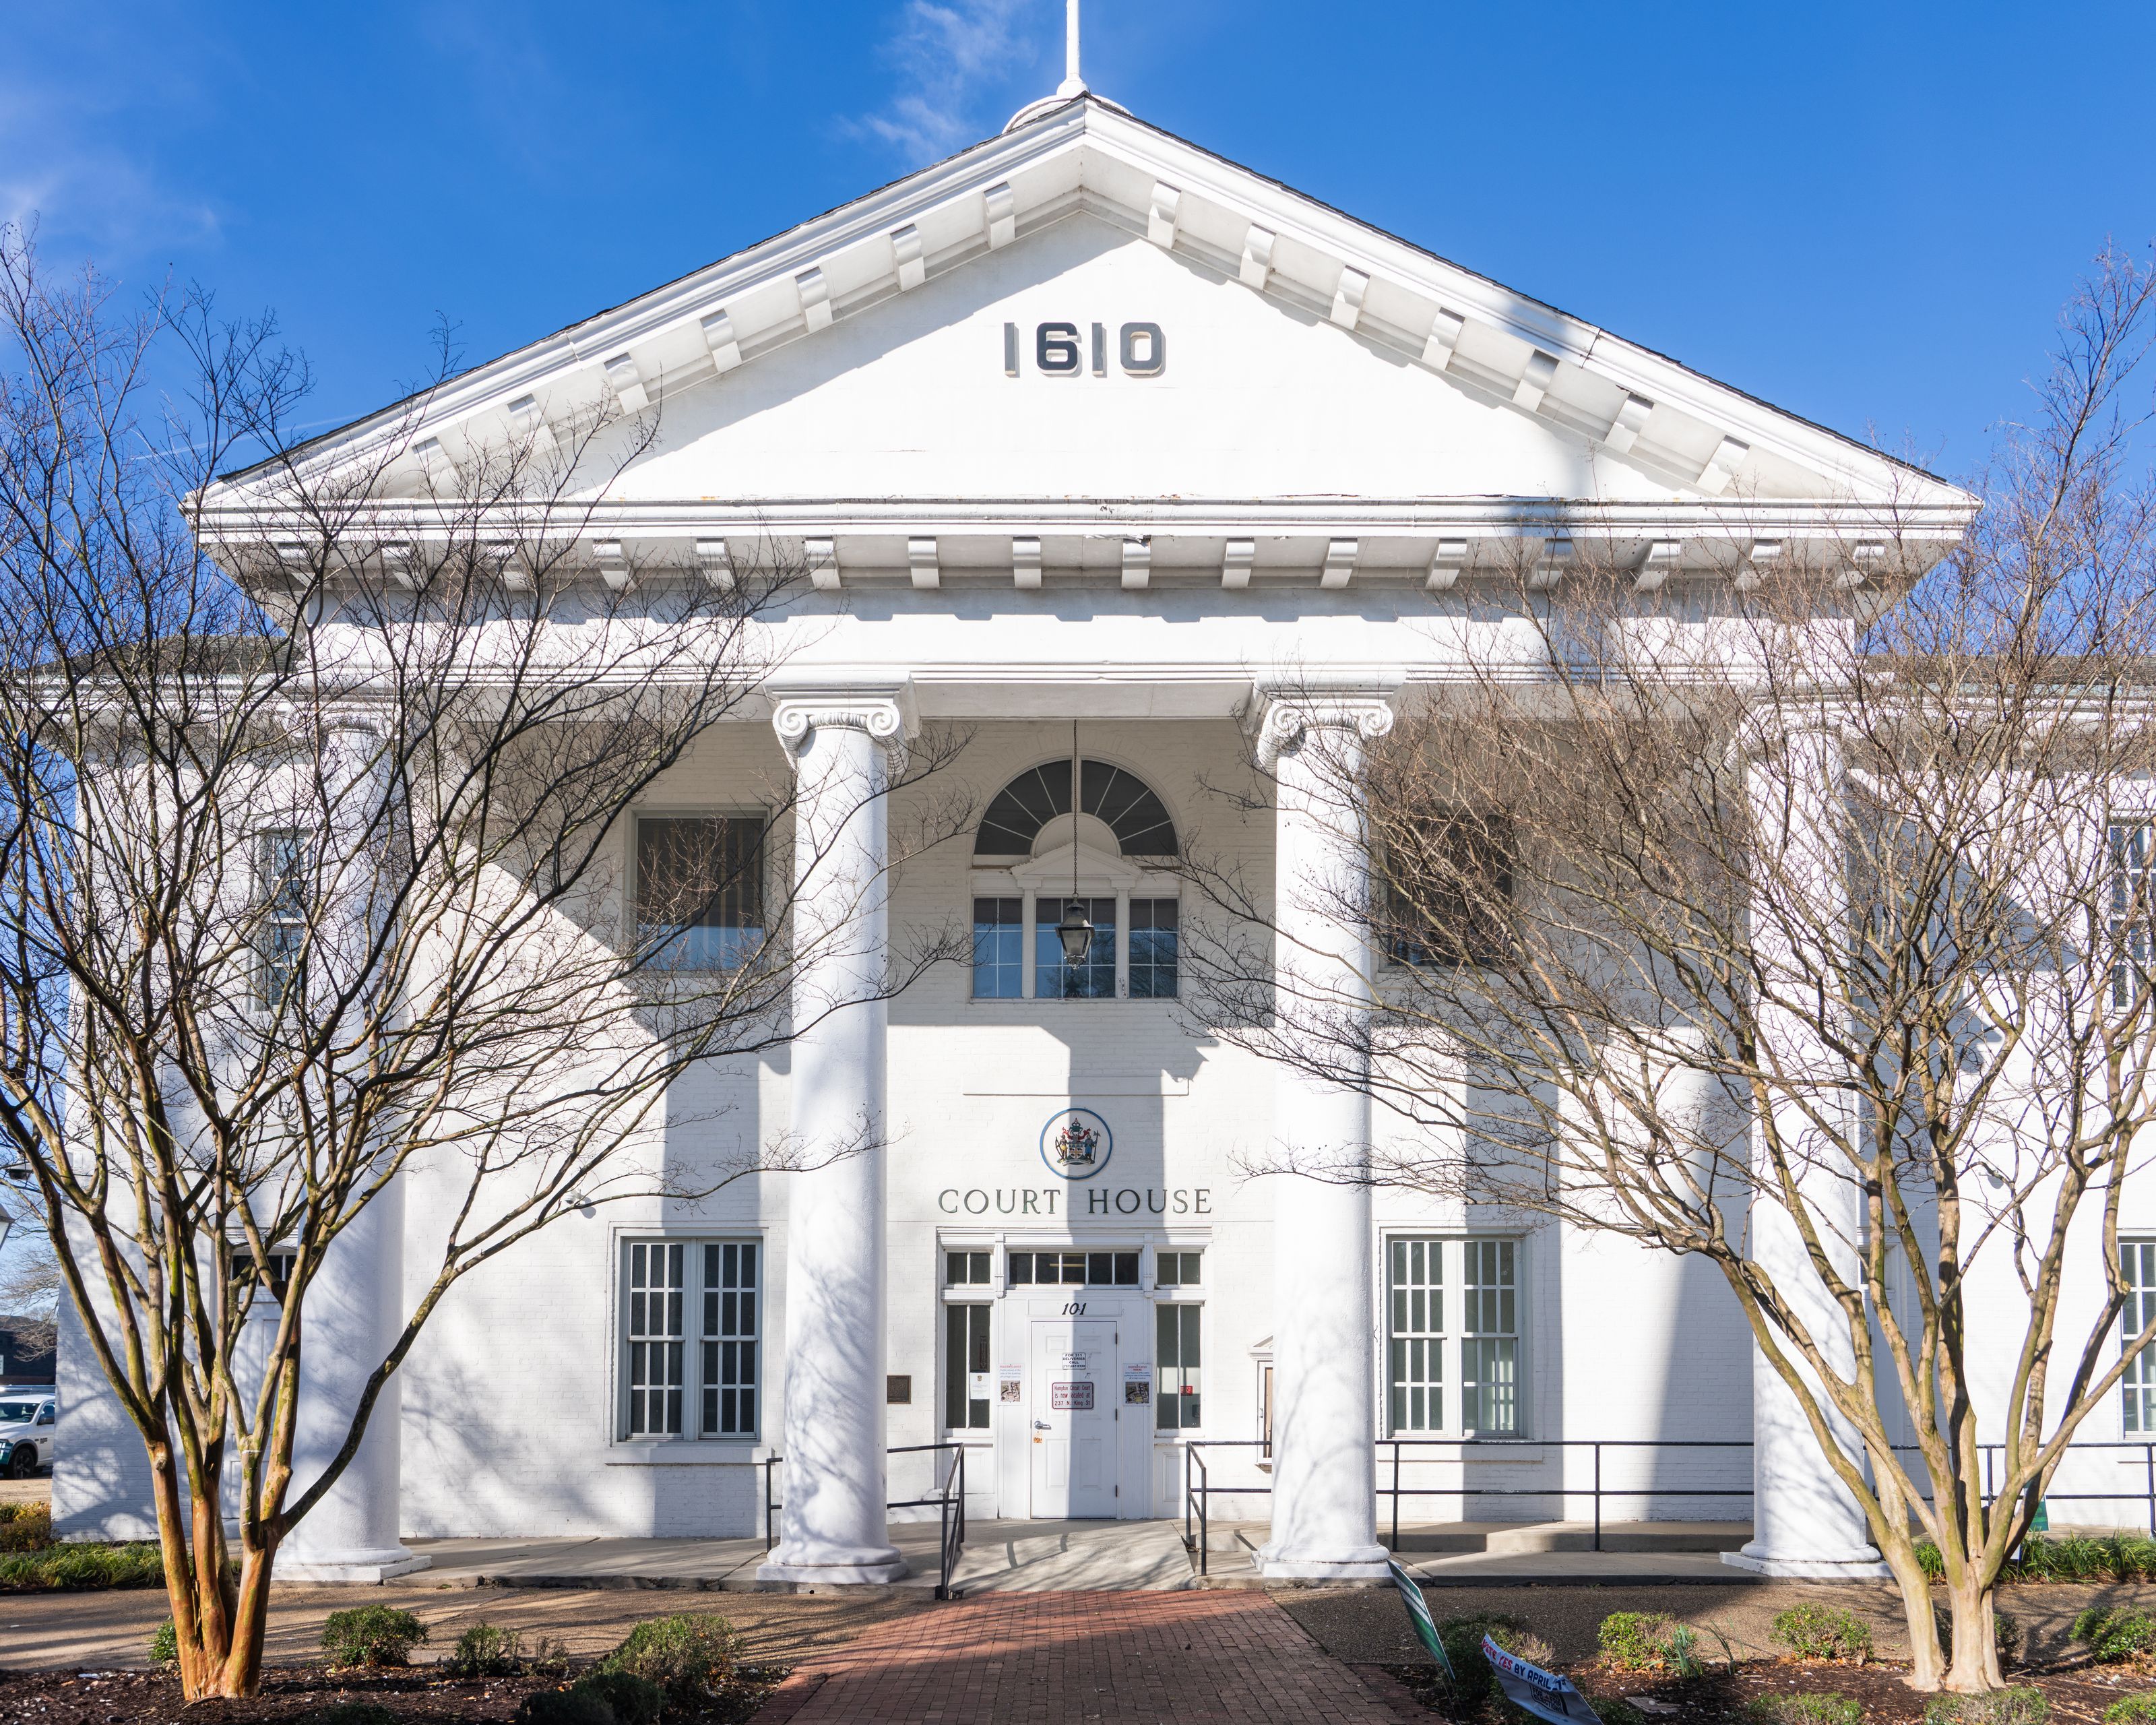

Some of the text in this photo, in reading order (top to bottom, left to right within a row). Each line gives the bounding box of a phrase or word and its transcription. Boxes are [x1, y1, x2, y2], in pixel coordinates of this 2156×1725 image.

[1004, 322, 1163, 375] 1610
[938, 1189, 1212, 1214] COURT HOUSE
[1062, 1303, 1087, 1315] 101
[1498, 1656, 1513, 1671] YES
[1514, 1662, 1526, 1676] BY
[1527, 1670, 1552, 1691] APRIL
